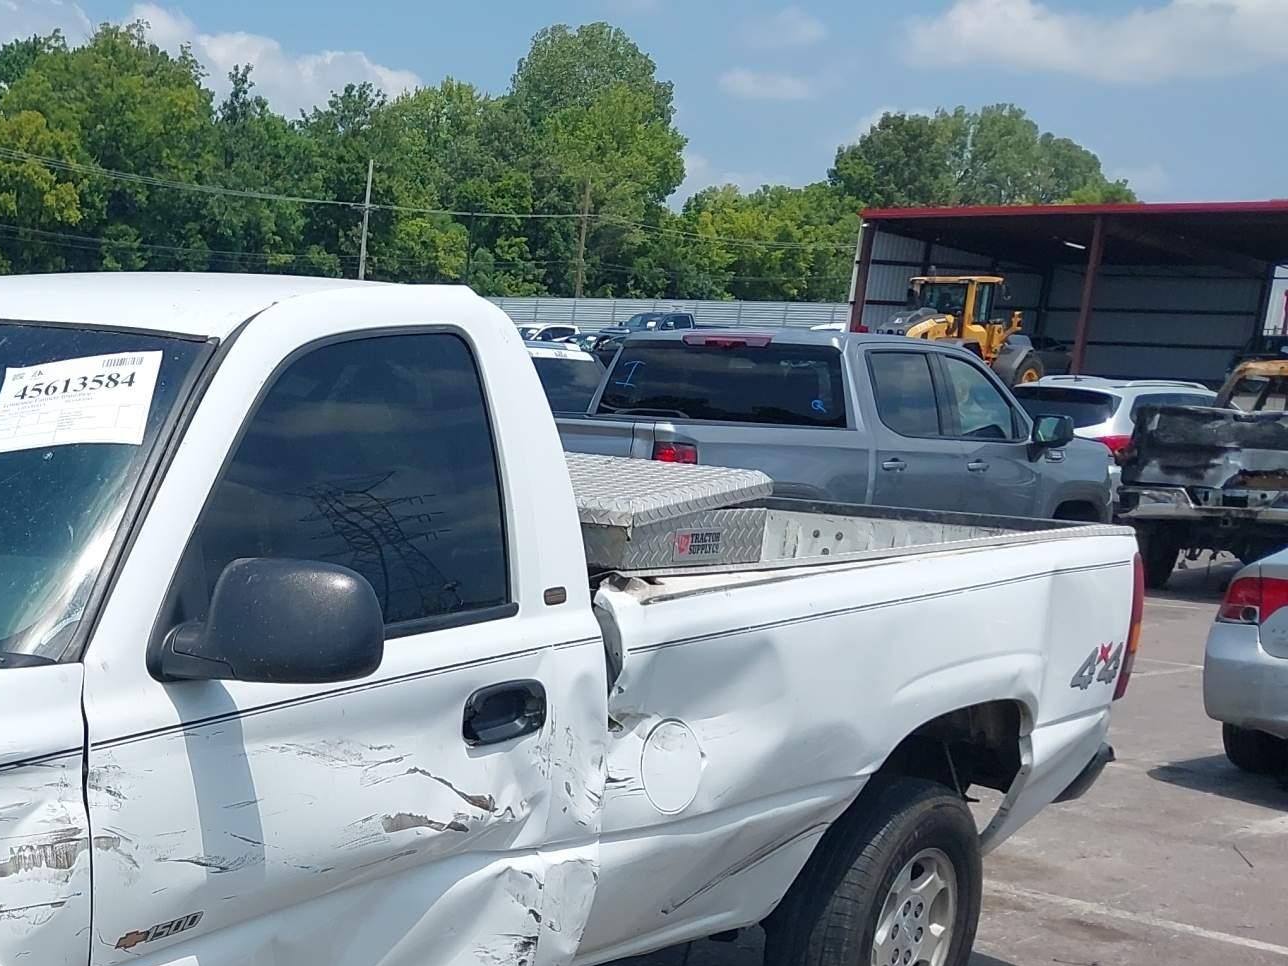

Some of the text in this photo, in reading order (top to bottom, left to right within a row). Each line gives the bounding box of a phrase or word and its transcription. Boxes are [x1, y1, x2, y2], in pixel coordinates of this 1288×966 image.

[14, 371, 136, 400] 45613584
[690, 532, 721, 544] TRACTOR
[688, 543, 712, 555] SUPPLY
[145, 910, 204, 943] 1500
